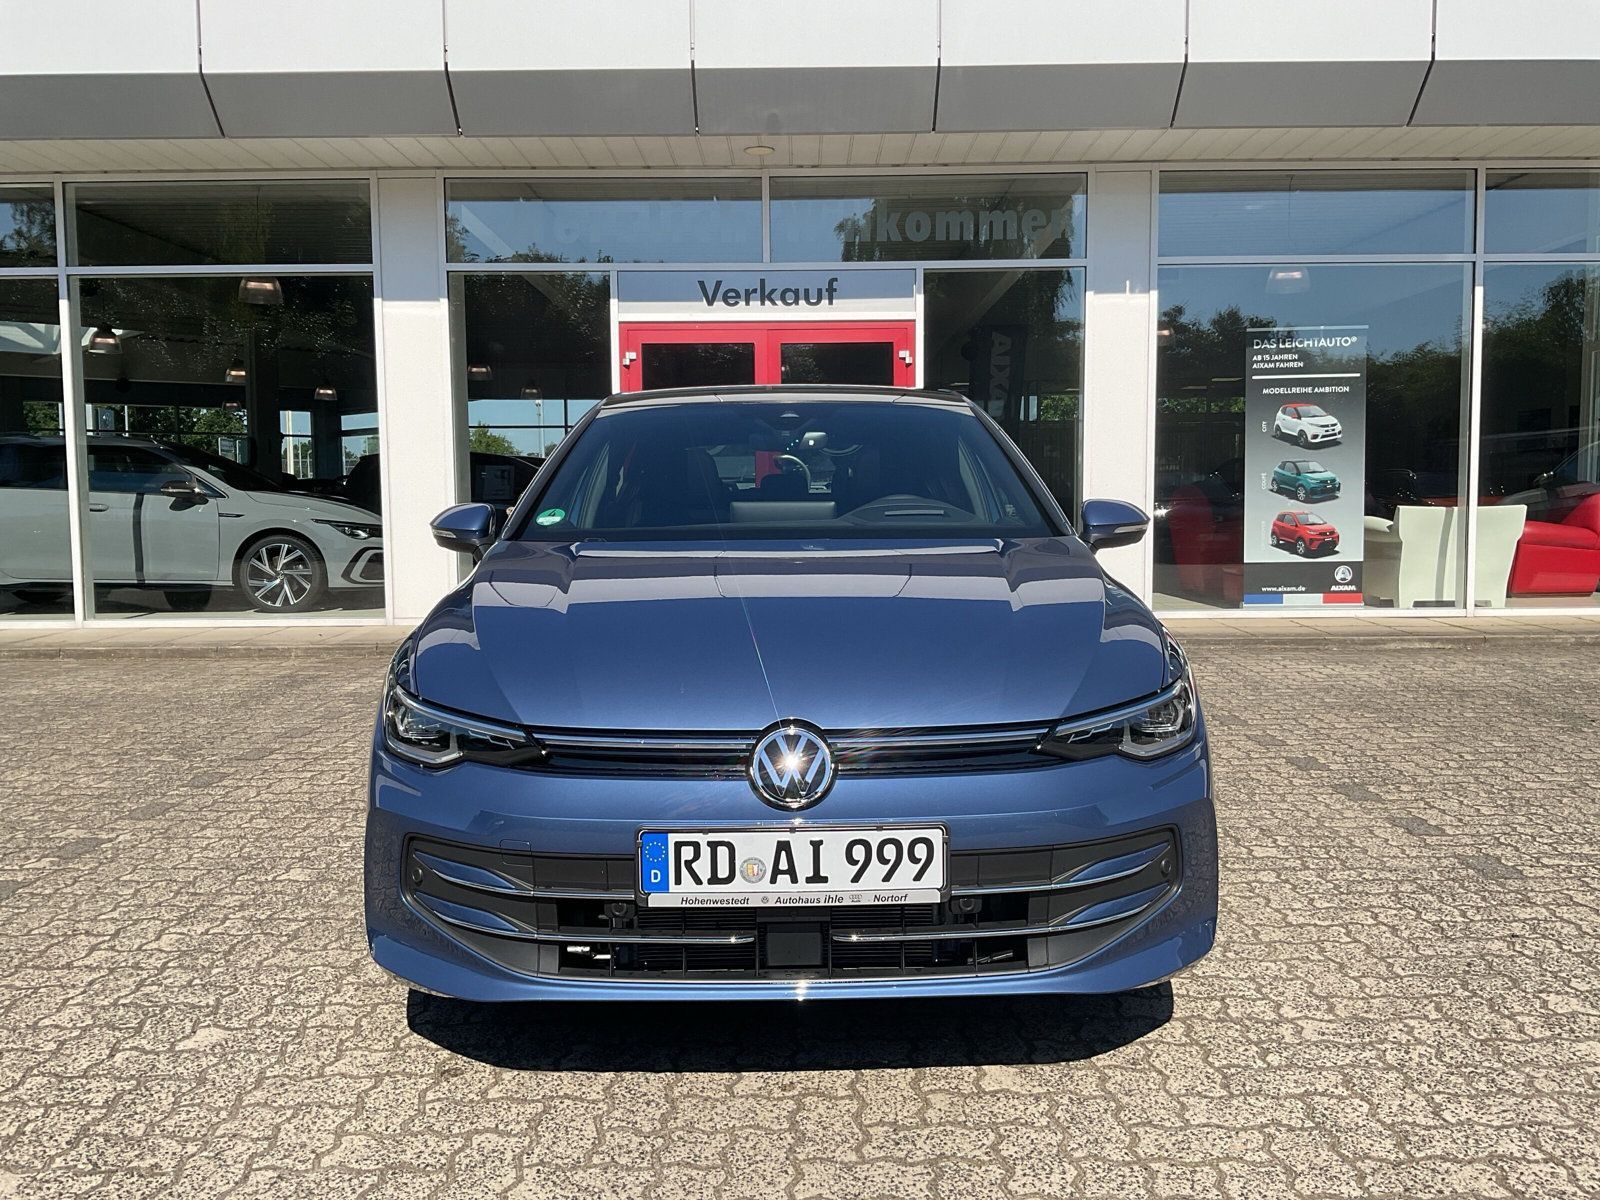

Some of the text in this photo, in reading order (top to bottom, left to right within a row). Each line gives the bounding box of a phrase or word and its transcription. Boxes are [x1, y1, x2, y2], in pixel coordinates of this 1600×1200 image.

[697, 277, 838, 307] Verkauf
[1253, 338, 1277, 349] DAS
[1270, 353, 1298, 361] JAHREN
[673, 840, 737, 886] RD
[769, 839, 829, 885] AI
[845, 837, 935, 883] 999
[650, 869, 661, 884] D
[680, 896, 750, 906] Hohenwestedt
[774, 896, 821, 905] Autohaus
[873, 893, 908, 903] Nortorf
